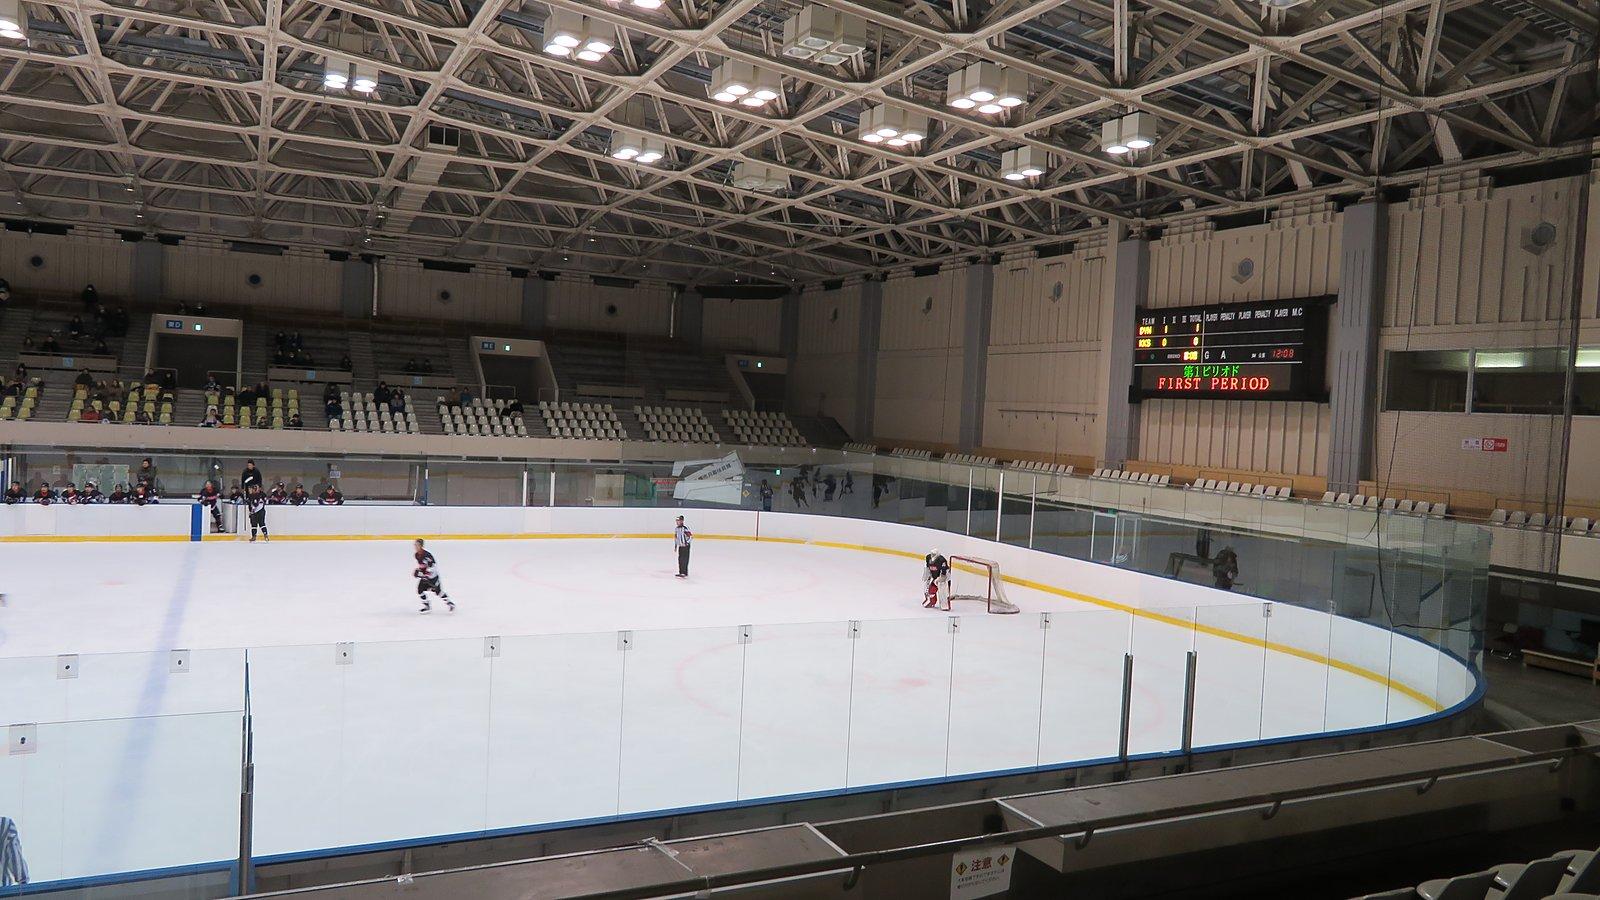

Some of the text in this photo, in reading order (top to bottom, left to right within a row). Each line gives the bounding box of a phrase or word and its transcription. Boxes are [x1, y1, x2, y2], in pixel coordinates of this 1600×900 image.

[1142, 317, 1155, 325] TEAM
[1189, 314, 1202, 323] TOTAL
[1205, 313, 1218, 322] PLAYER
[1220, 312, 1236, 321] PENALTY
[1238, 310, 1252, 320] PLAYER
[1254, 309, 1271, 319] PENALTY
[1274, 308, 1289, 318] PLAYER
[1204, 350, 1210, 360] G
[1220, 350, 1227, 360] A
[1183, 365, 1240, 378] 第1ピリオド
[1158, 377, 1270, 391] FIRST PERIOD
[970, 856, 993, 872] 注意
